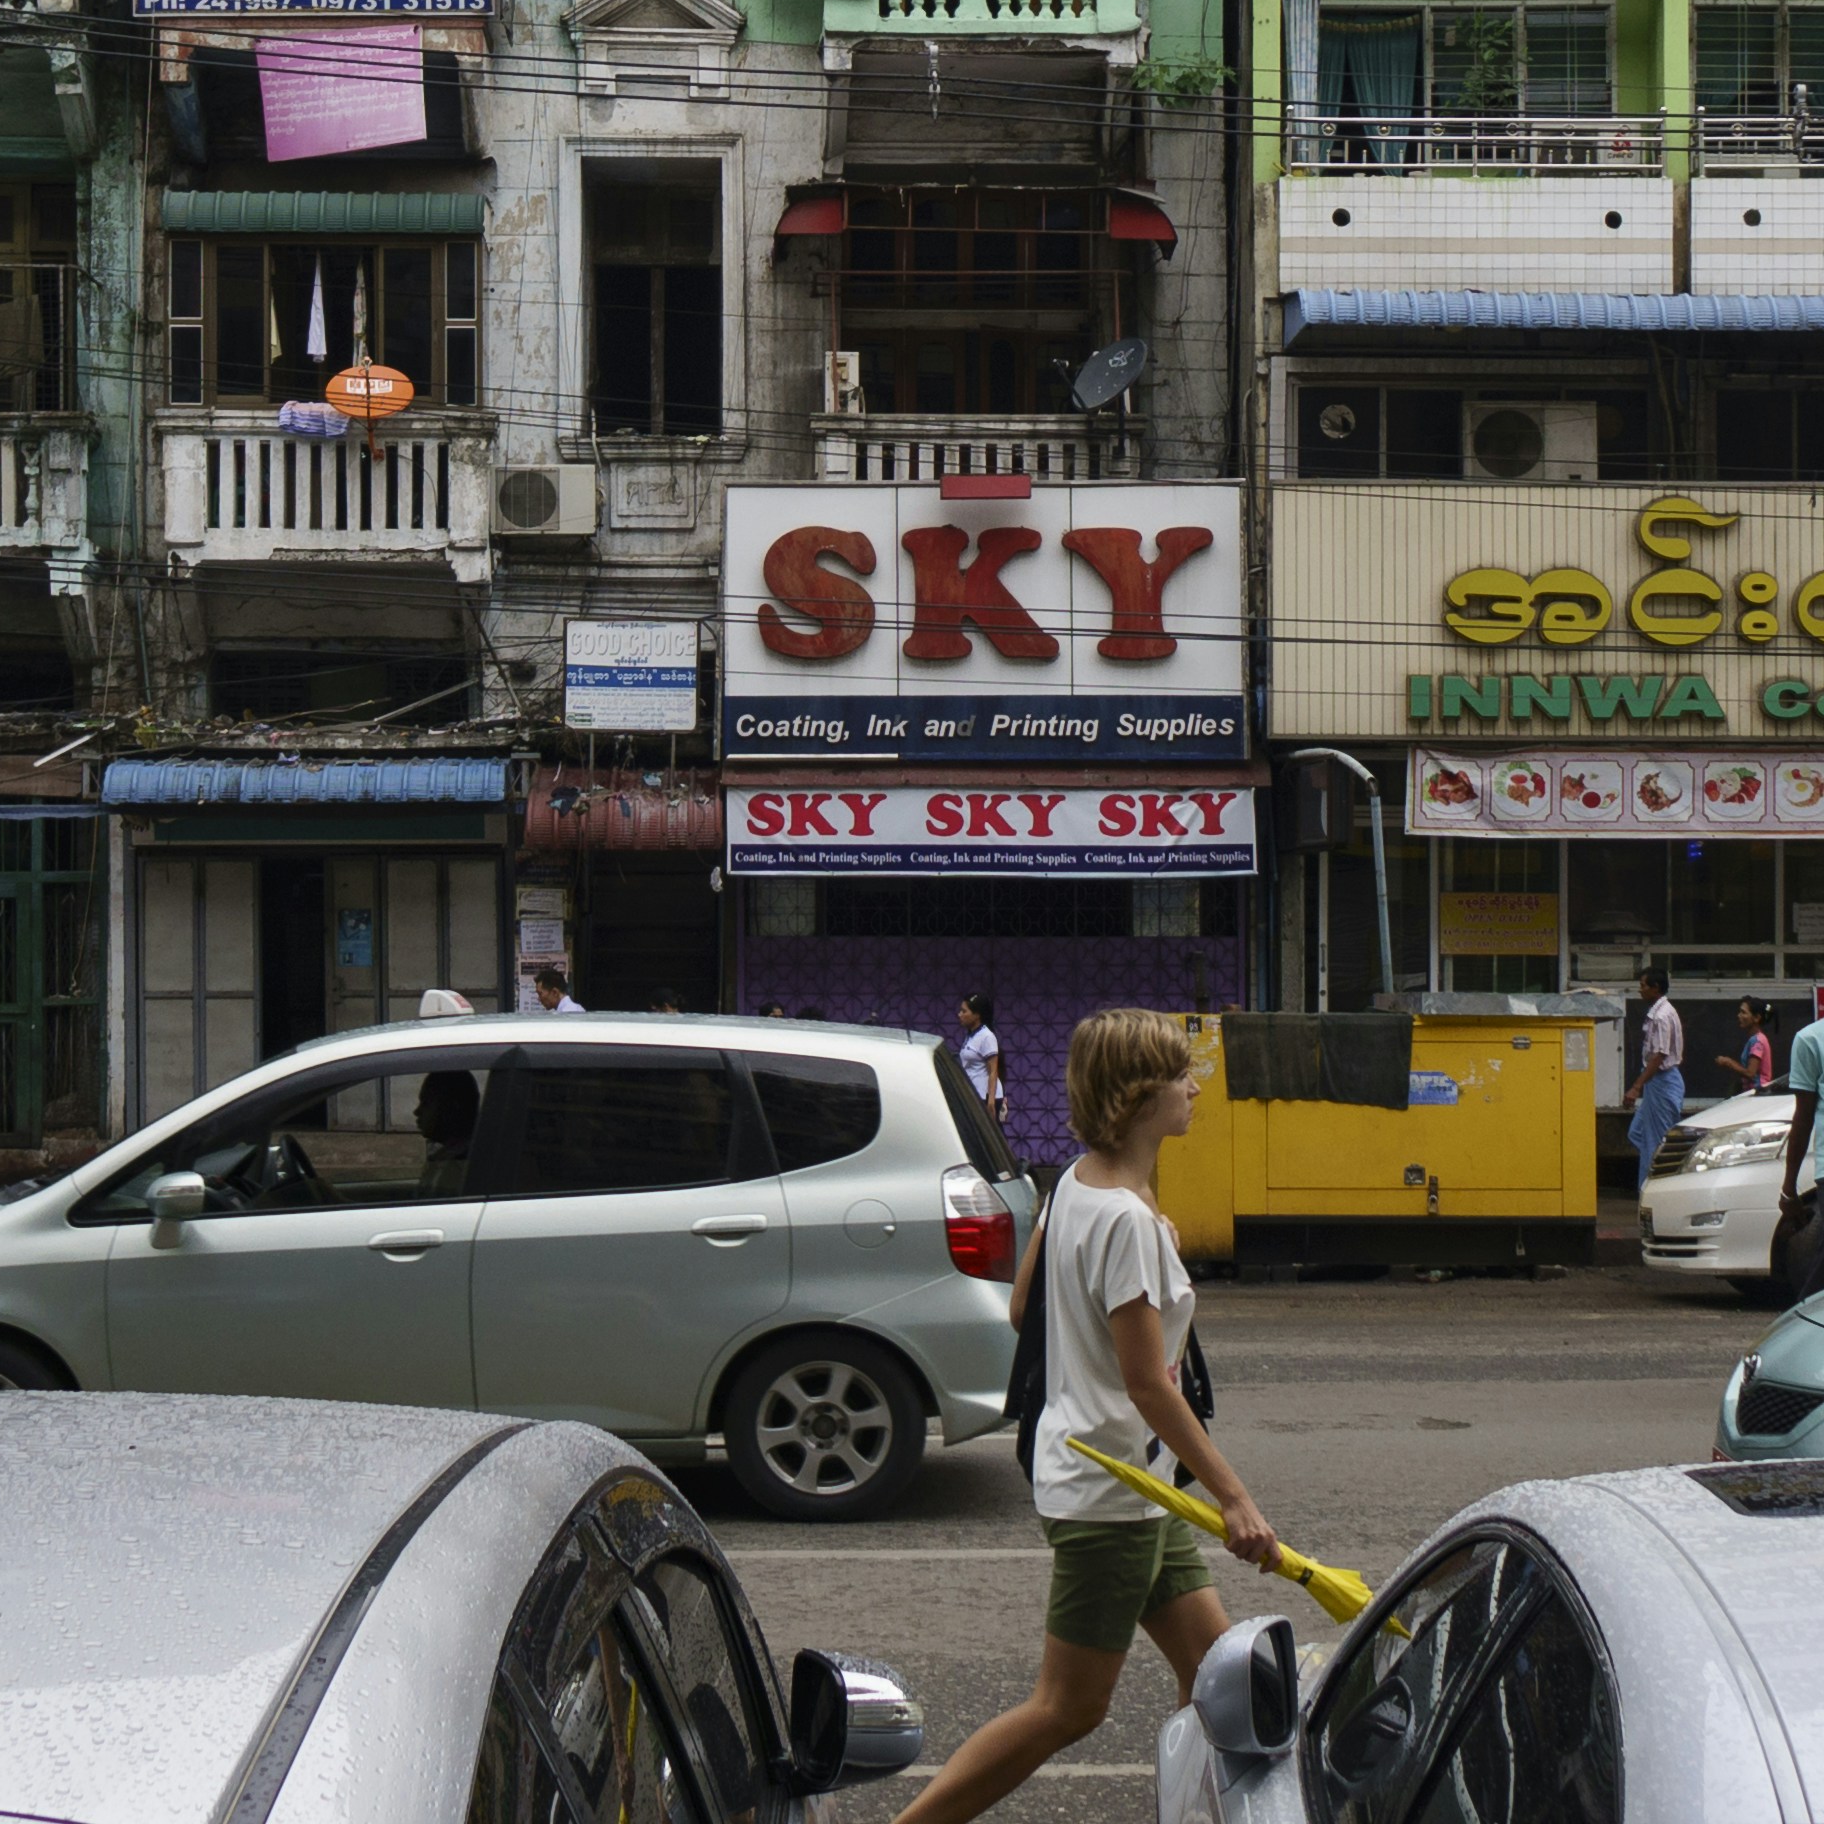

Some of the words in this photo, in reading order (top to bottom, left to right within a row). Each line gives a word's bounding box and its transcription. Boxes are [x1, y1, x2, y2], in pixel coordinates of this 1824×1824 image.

[758, 524, 1214, 661] SKY
[571, 633, 622, 656] GOOD
[629, 631, 696, 656] CHOICE
[1406, 674, 1726, 721] INNWA
[736, 714, 850, 743] Coating,
[867, 714, 908, 737] Ink
[925, 714, 973, 737] and
[990, 714, 1099, 742] Printing
[1117, 713, 1235, 742] Supplies
[746, 792, 887, 837] SKY
[926, 793, 1066, 837] SKY
[1098, 792, 1238, 837] SKY
[735, 851, 776, 864] Coating,
[779, 852, 796, 863] Ink
[798, 852, 816, 863] and
[818, 852, 858, 865] Printing
[860, 852, 902, 865] Supplies
[910, 852, 951, 865] Coating,
[954, 853, 971, 863] Ink
[973, 853, 991, 863] and
[994, 852, 1033, 866] Printing
[1036, 852, 1076, 866] Supplies
[1084, 852, 1126, 865] Coating,
[1128, 852, 1145, 863] Ink
[1147, 852, 1165, 863] and
[1168, 852, 1207, 865] Printing
[1209, 851, 1250, 864] Supplies
